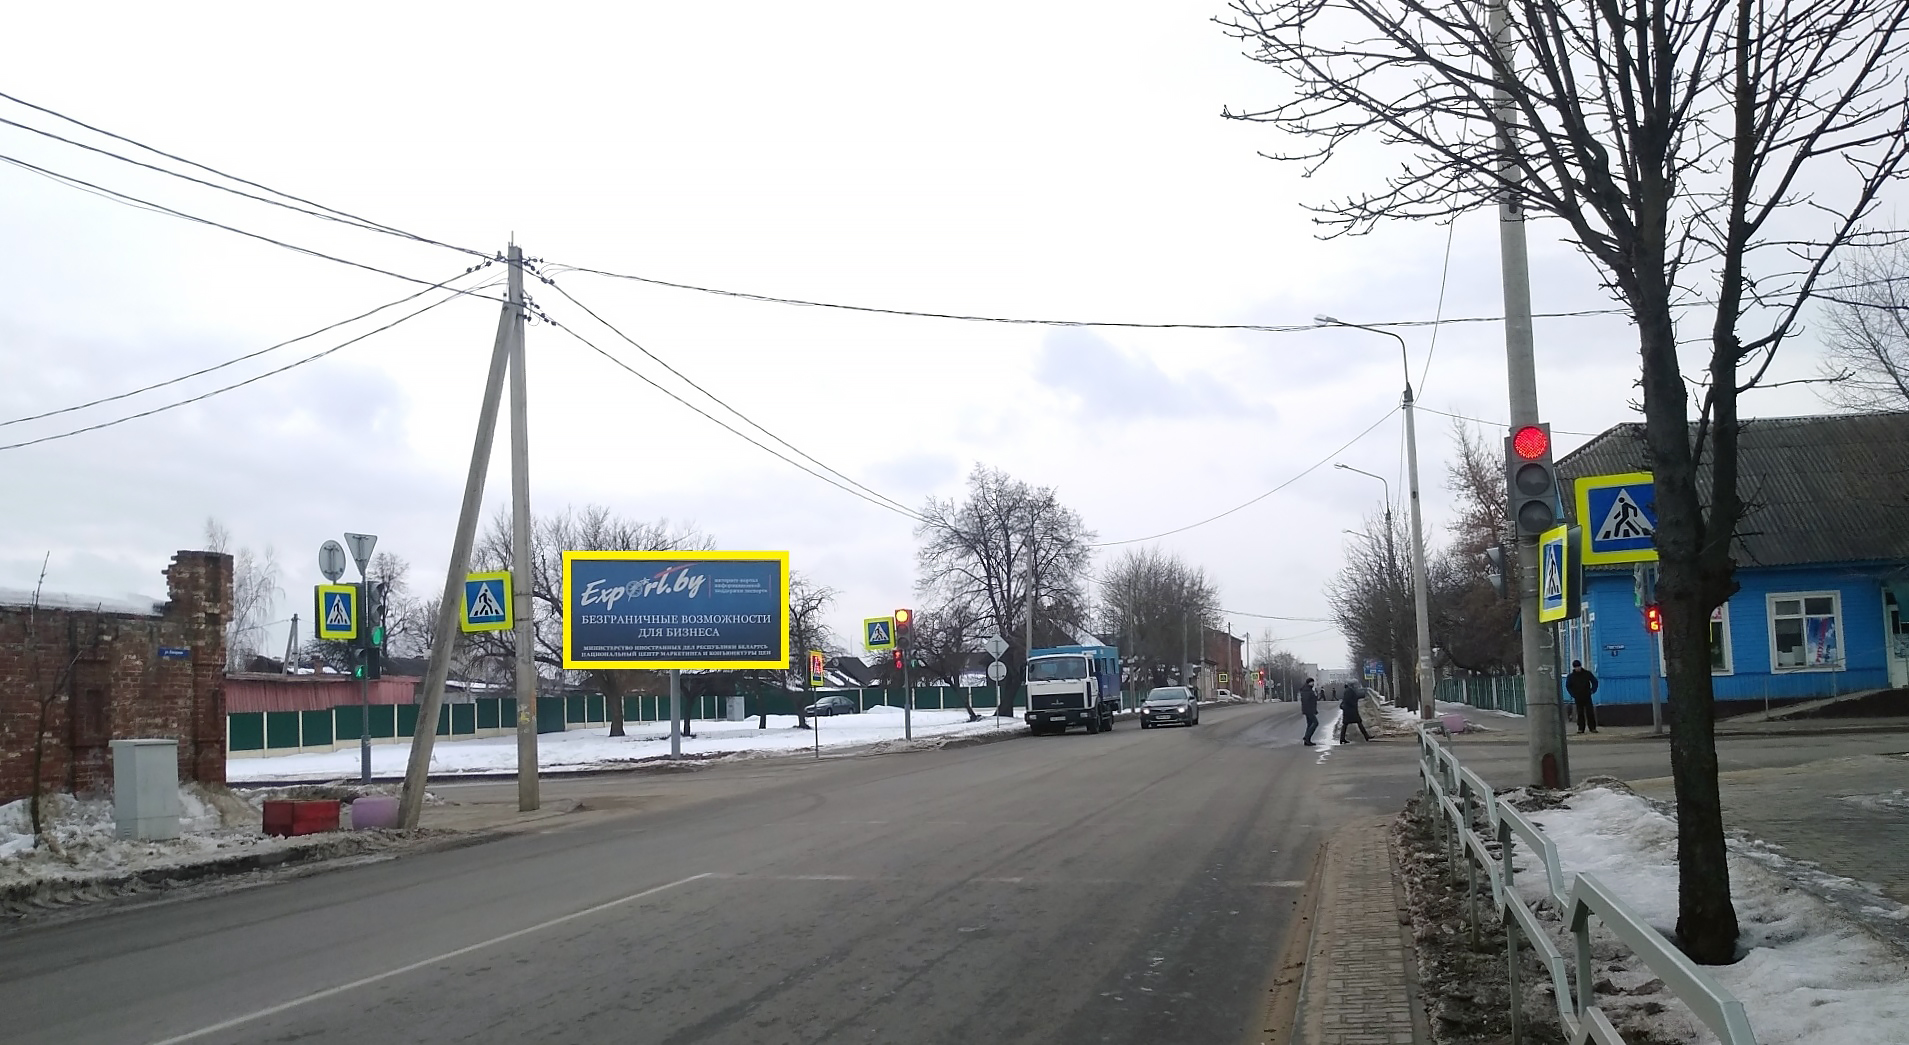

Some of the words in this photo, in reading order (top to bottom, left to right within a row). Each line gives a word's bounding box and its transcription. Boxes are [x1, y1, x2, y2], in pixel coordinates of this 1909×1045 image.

[581, 566, 706, 611] Export.by
[582, 614, 679, 624] БЕЗГРАНИЧНЫЕ
[682, 614, 771, 624] ВОЗМОЖНОСТИ
[638, 628, 663, 638] ДЛЯ
[666, 627, 720, 637] БИЗНЕСА
